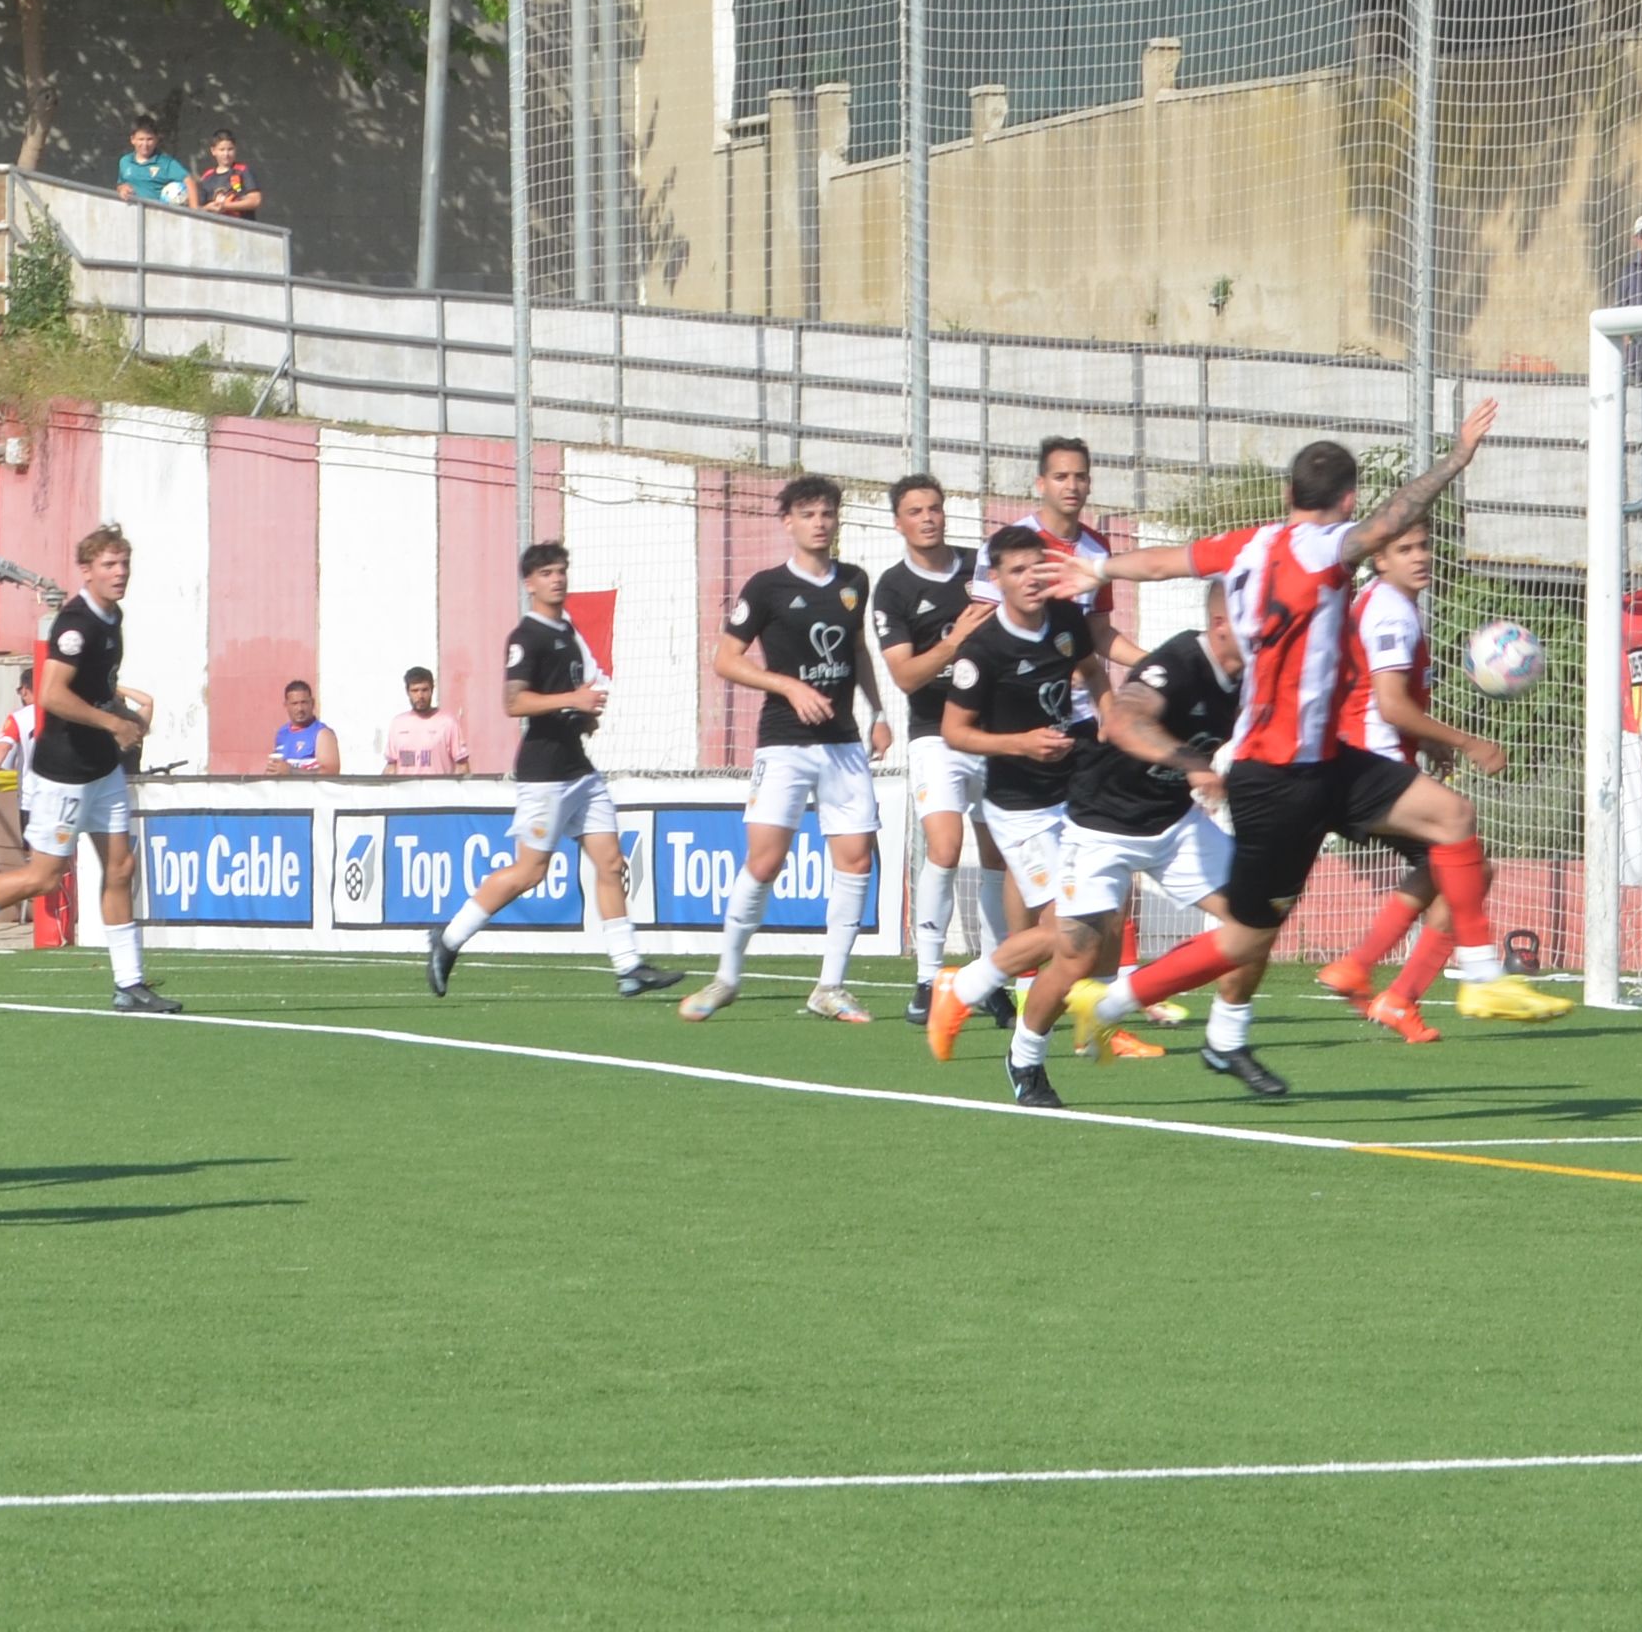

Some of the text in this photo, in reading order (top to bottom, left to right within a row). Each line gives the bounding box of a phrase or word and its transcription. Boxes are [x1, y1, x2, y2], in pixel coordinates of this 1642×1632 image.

[58, 796, 80, 825] 12
[150, 834, 300, 912] Top Cable
[394, 835, 452, 915] Top
[666, 831, 736, 916] Top
